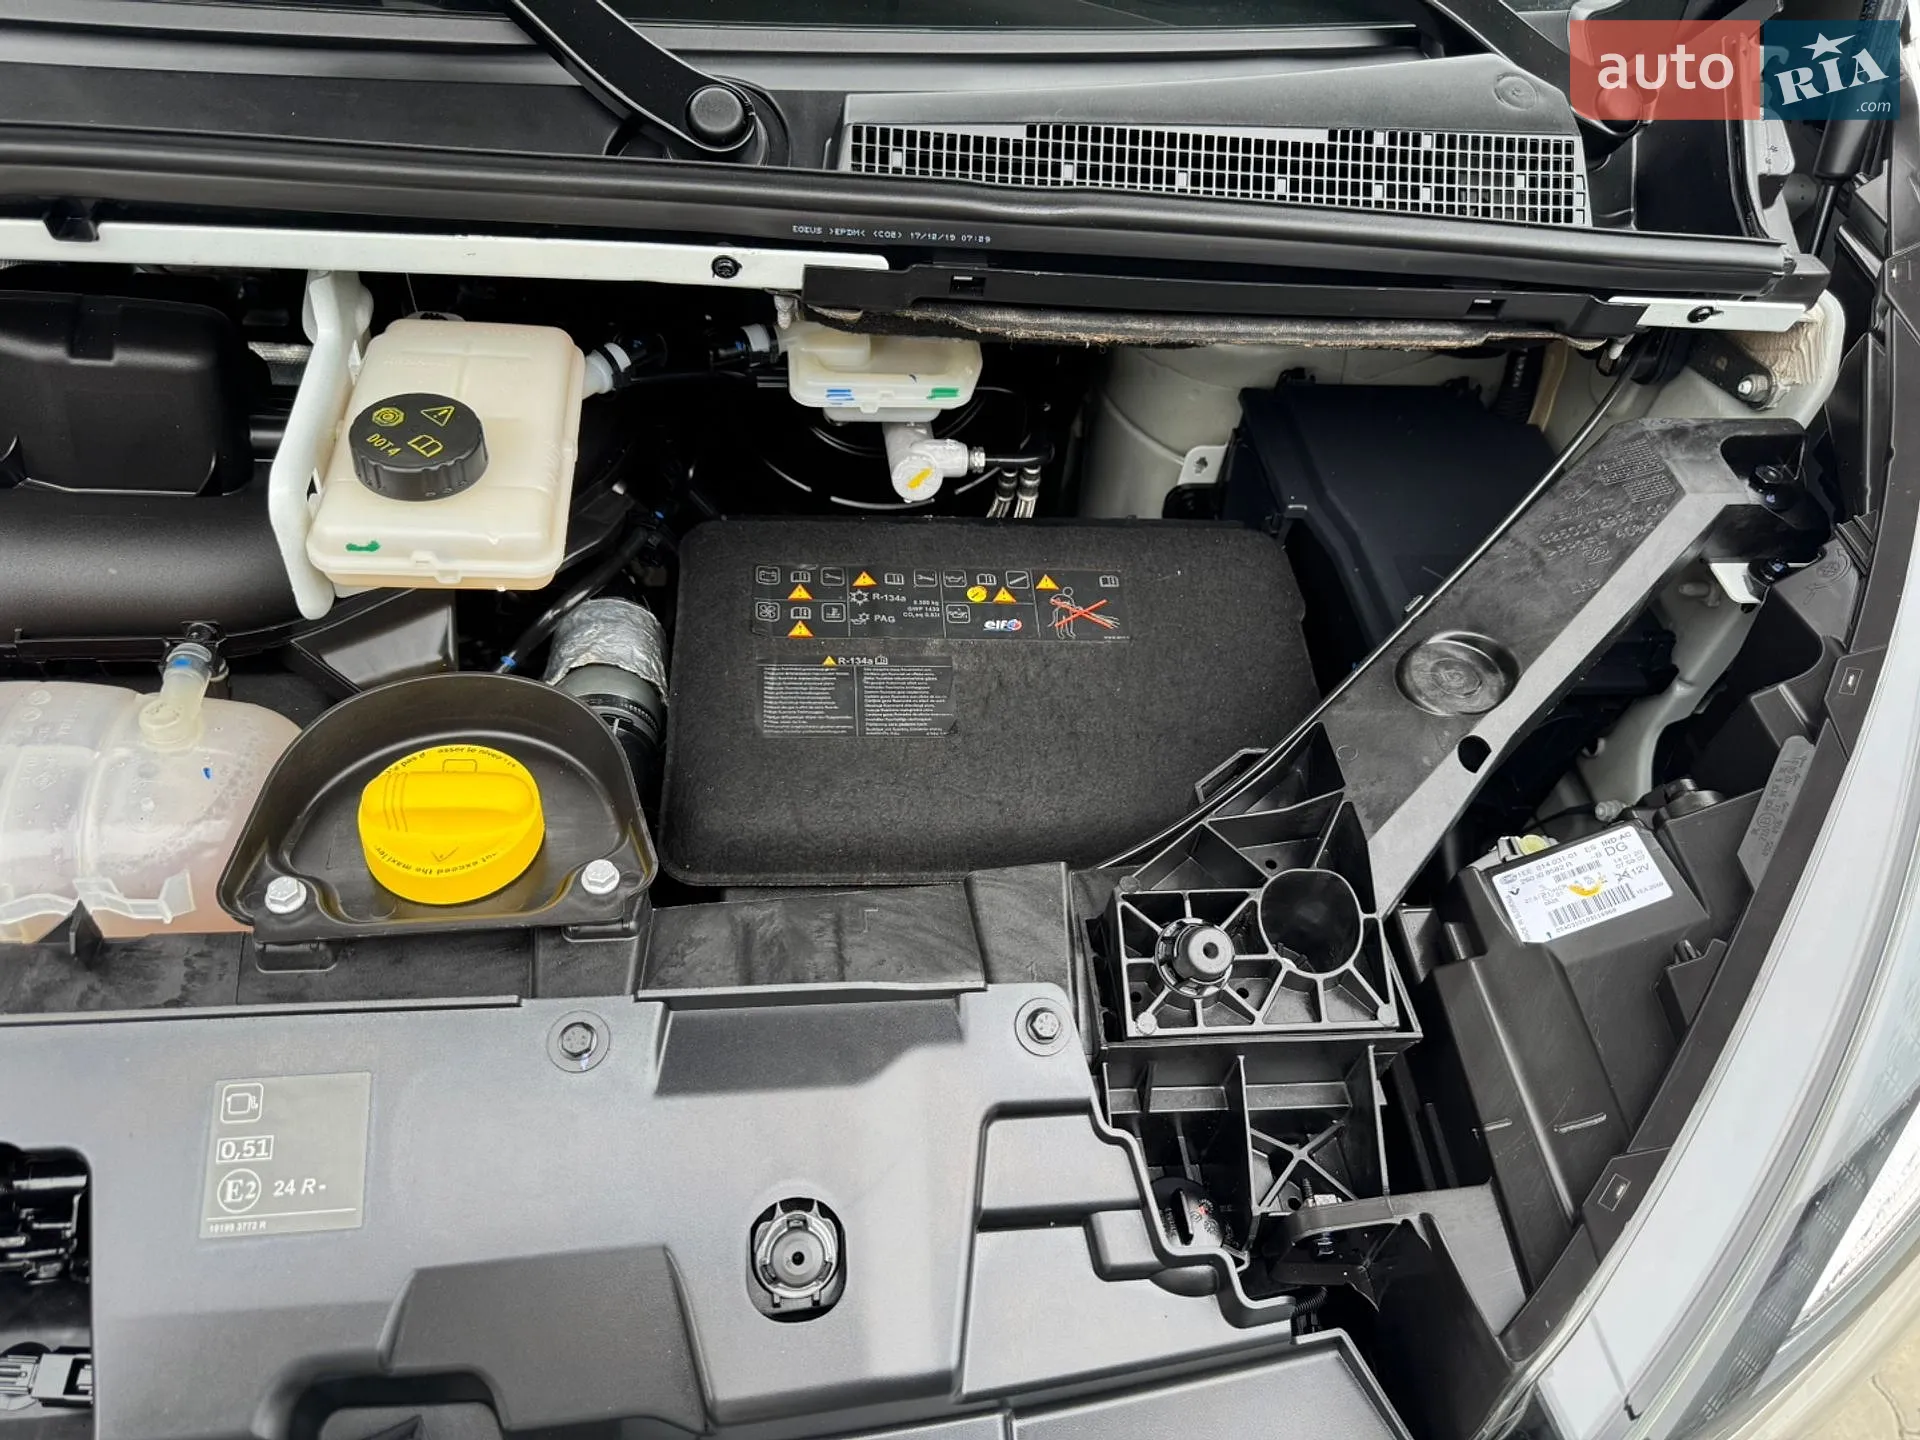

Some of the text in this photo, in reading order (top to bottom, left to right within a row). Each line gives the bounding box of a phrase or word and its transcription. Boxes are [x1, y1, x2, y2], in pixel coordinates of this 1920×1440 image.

[872, 593, 907, 602] R-134a
[874, 614, 896, 624] PAG
[984, 619, 1008, 630] elf
[838, 656, 873, 665] R-134a
[401, 757, 417, 768] pas
[1604, 841, 1629, 857] DG
[388, 856, 412, 870] maxi
[436, 860, 479, 875] exceed
[415, 866, 433, 875] the
[1631, 863, 1649, 875] 12V
[220, 1140, 269, 1160] 0,51
[223, 1179, 258, 1203] E2
[272, 1181, 296, 1197] 24
